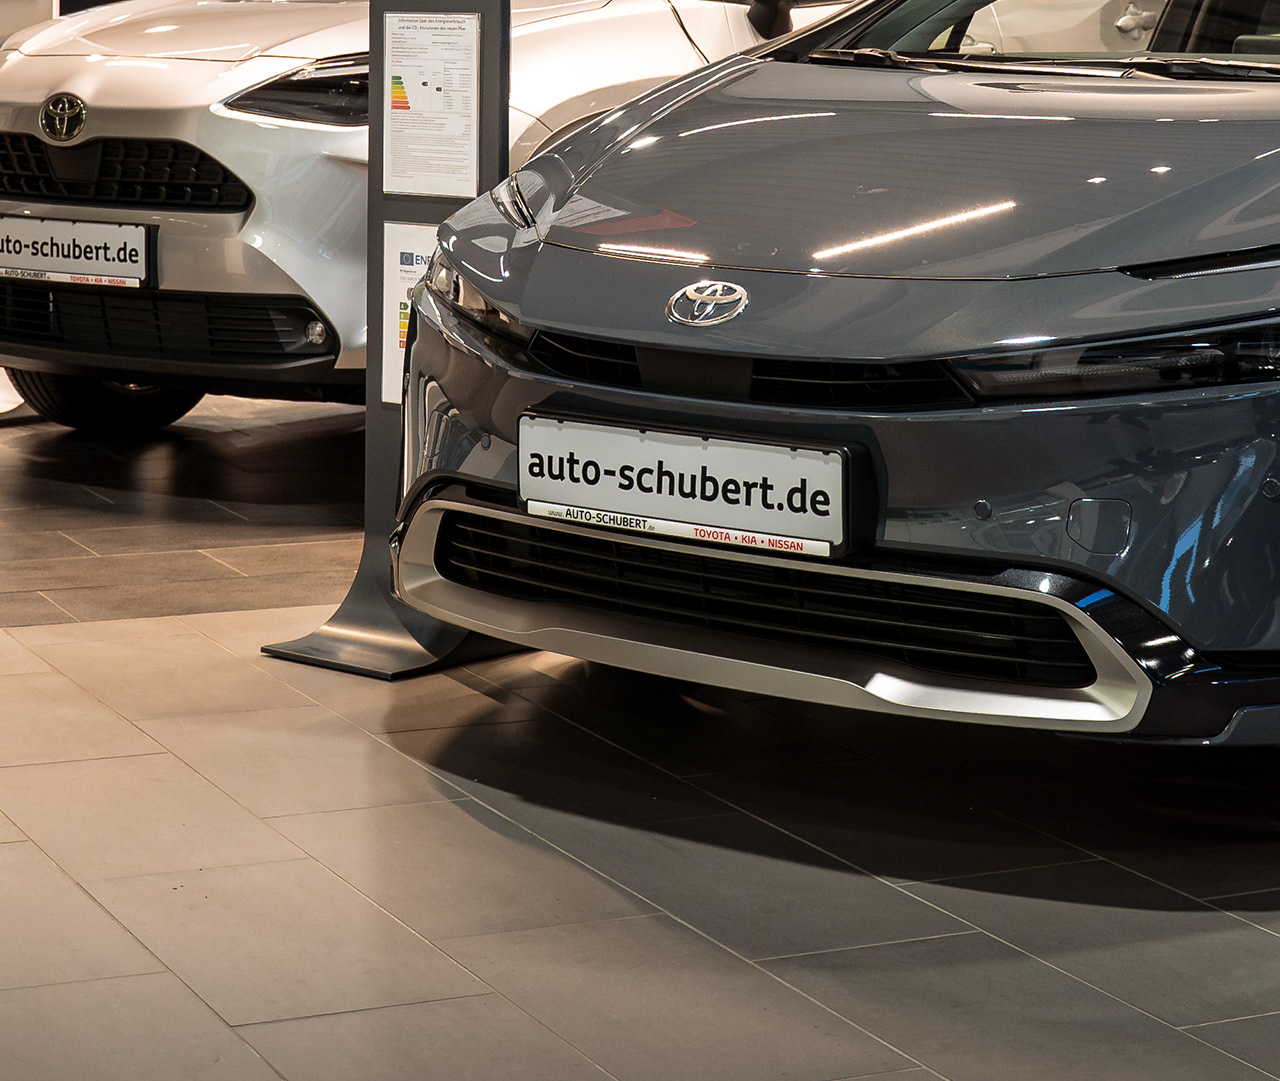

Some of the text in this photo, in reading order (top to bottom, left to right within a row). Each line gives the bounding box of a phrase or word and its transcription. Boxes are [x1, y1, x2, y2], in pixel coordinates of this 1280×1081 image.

[528, 451, 830, 517] auto-schubert.de
[694, 528, 731, 542] TOYOTA
[742, 533, 758, 546] KIA
[768, 538, 804, 552] NISSAN
